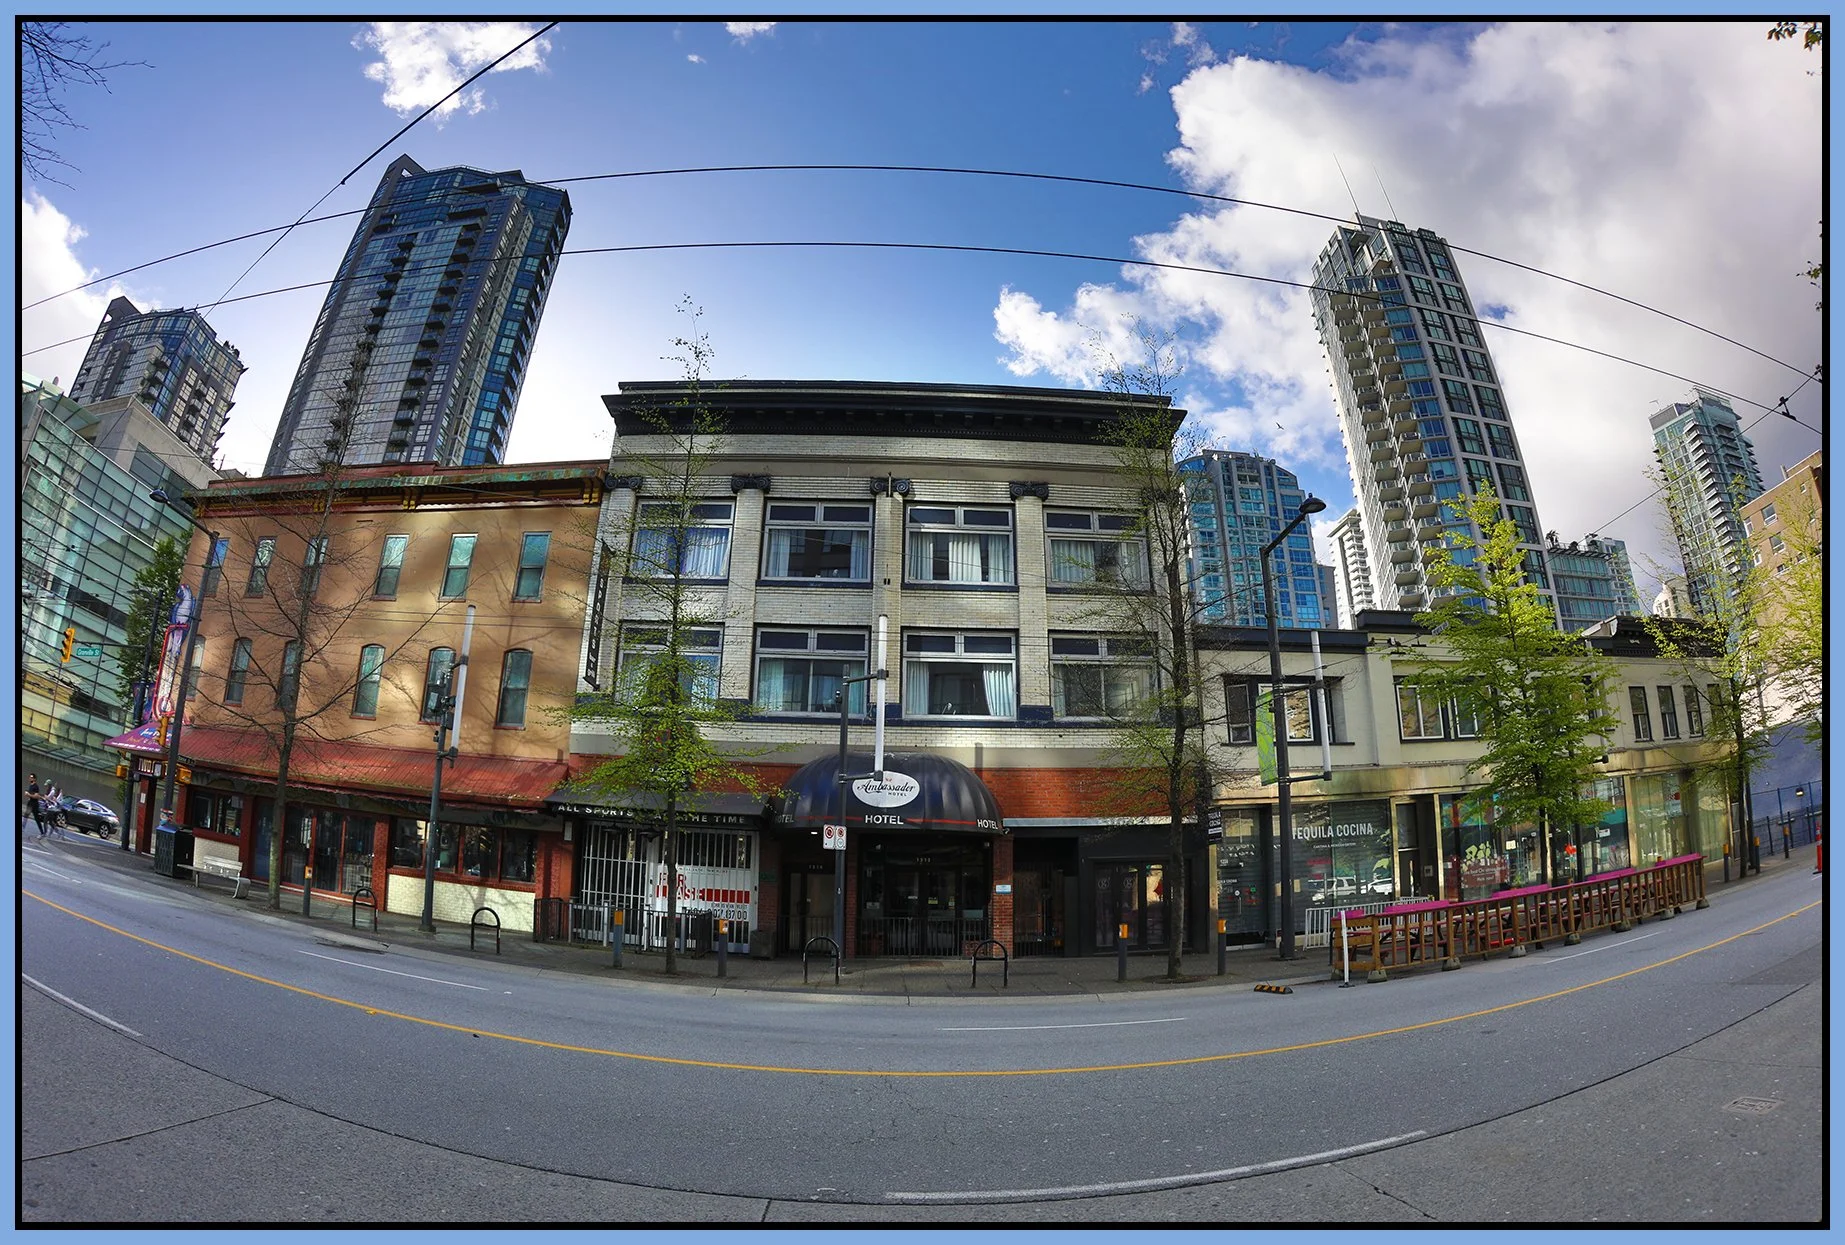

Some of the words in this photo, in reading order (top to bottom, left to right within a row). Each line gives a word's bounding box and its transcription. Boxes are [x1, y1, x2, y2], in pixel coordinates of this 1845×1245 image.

[856, 779, 916, 794] Ambassador
[558, 804, 580, 813] ALL
[585, 806, 634, 817] SPORTS
[713, 815, 745, 824] TIME
[864, 814, 904, 825] HOTEL
[977, 818, 999, 830] HOTEL
[1291, 825, 1335, 841] TEQUILA
[1336, 822, 1374, 837] COCINA
[659, 872, 687, 889] FR
